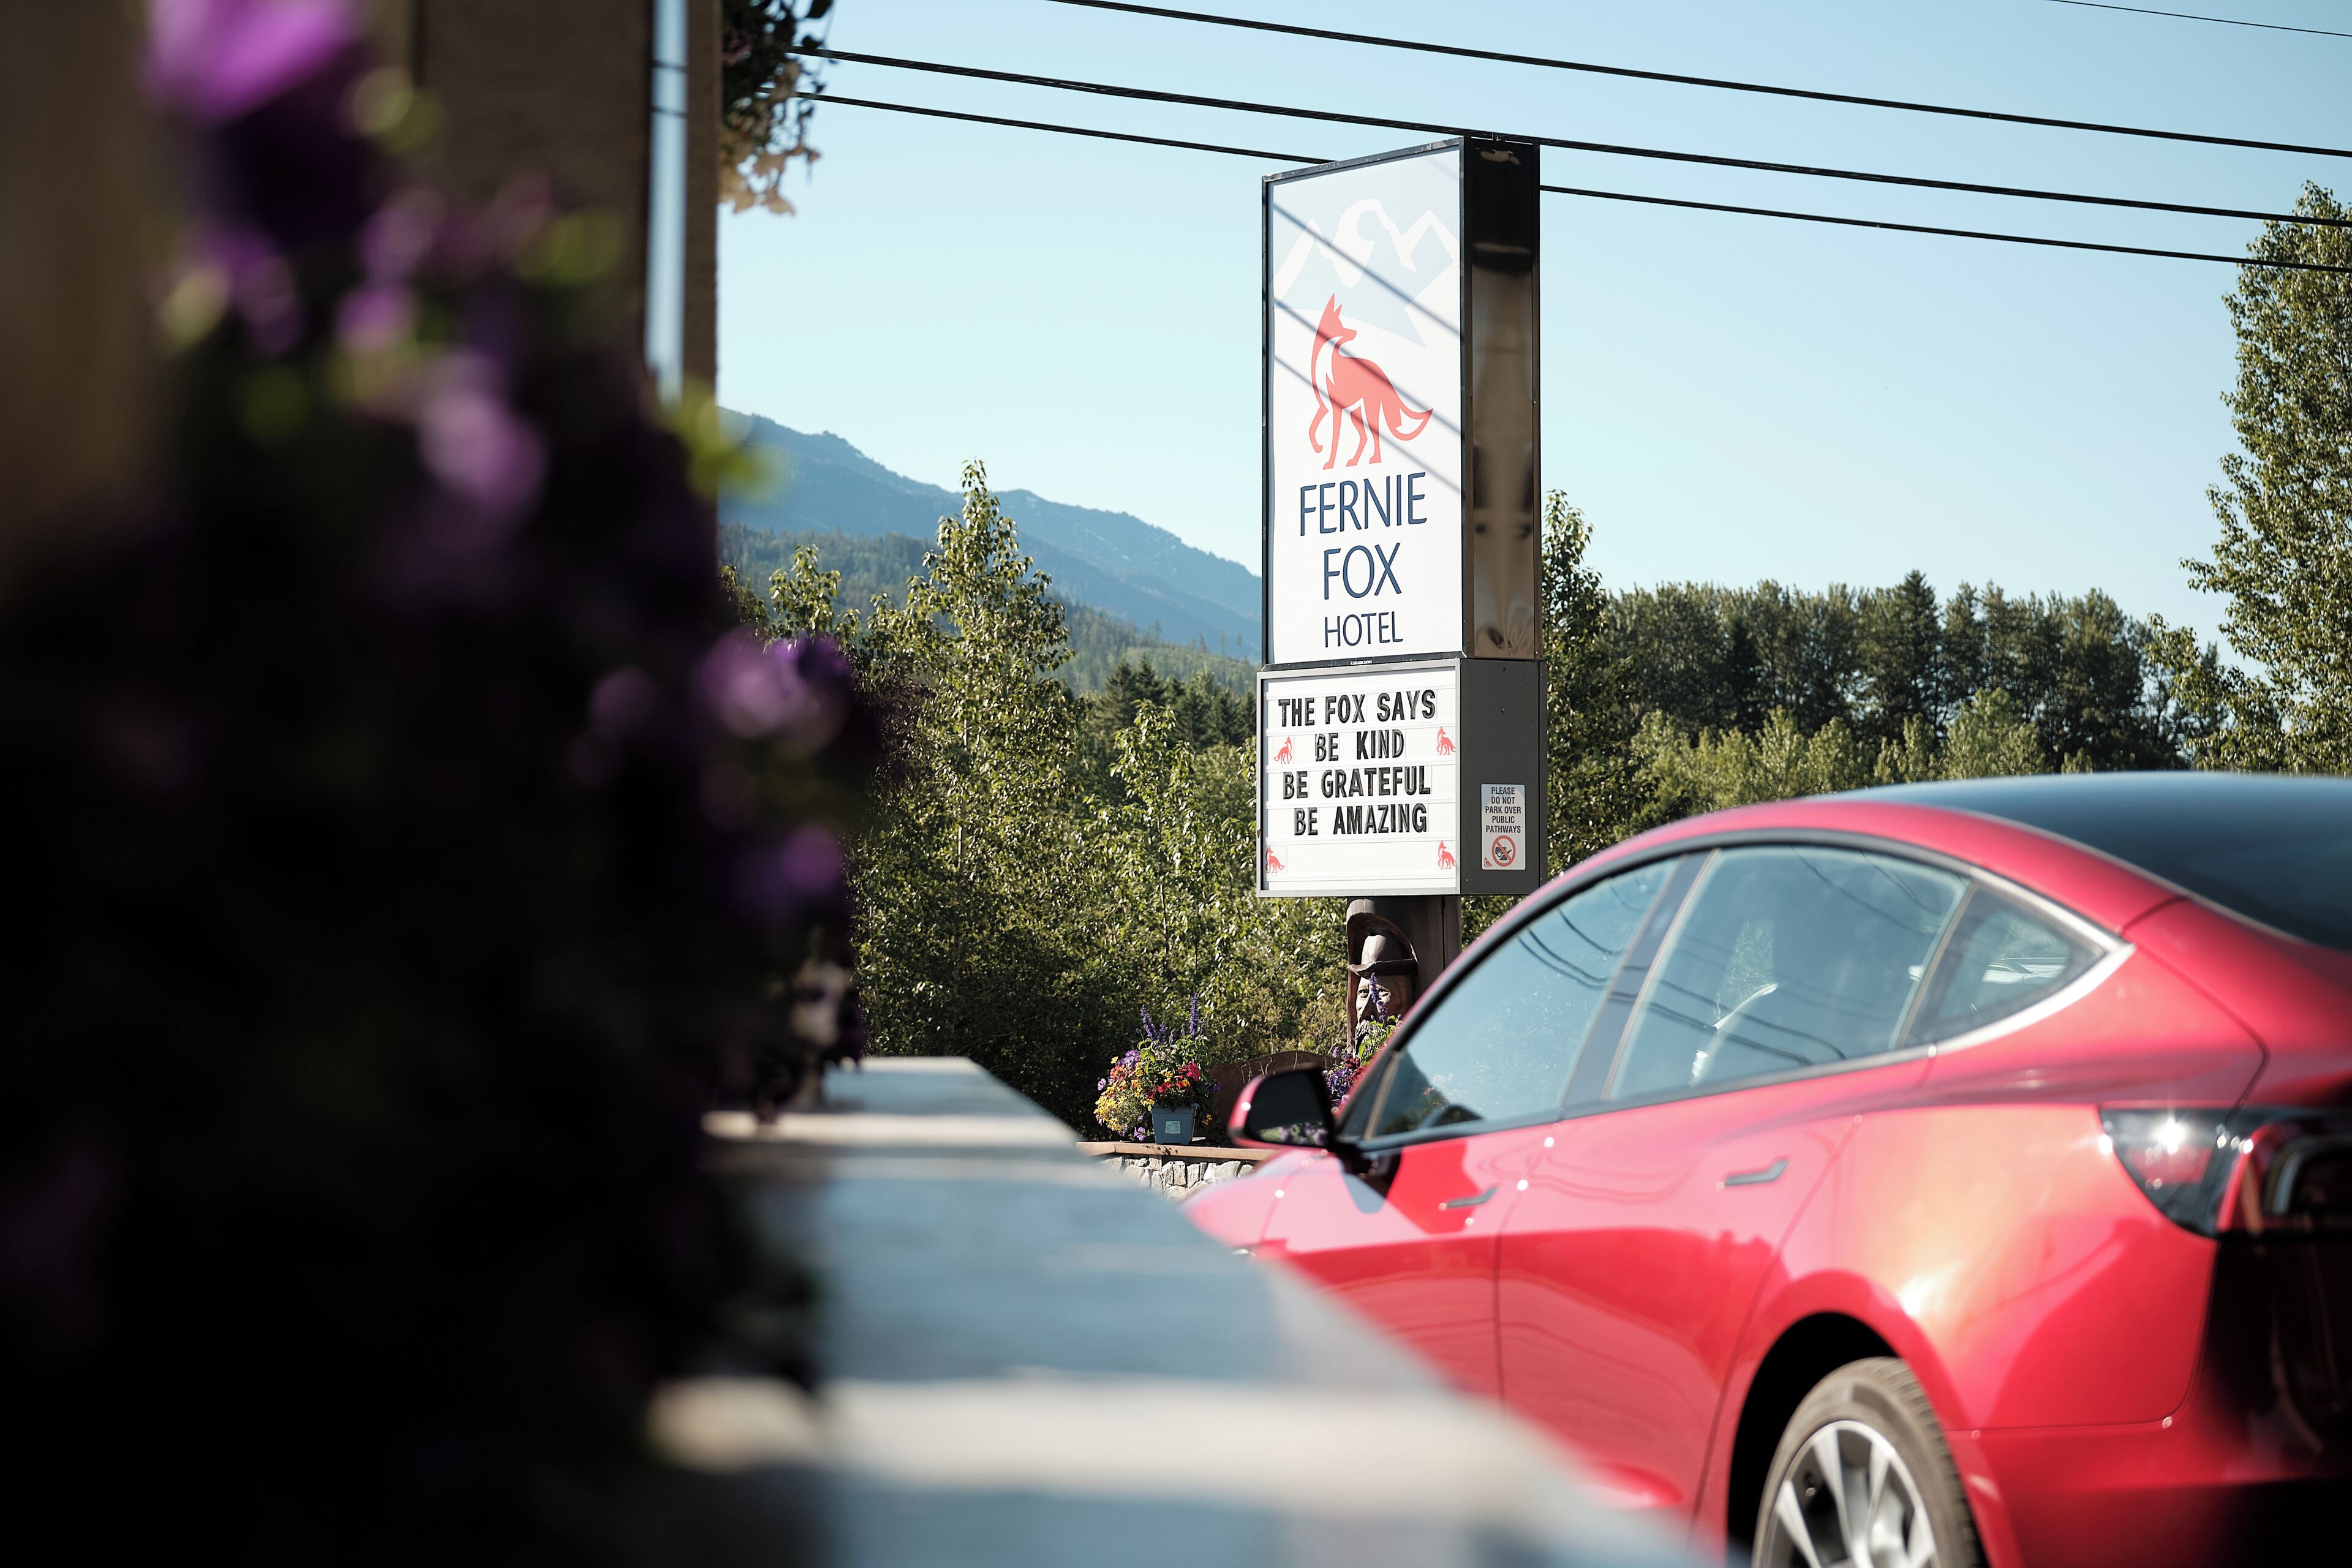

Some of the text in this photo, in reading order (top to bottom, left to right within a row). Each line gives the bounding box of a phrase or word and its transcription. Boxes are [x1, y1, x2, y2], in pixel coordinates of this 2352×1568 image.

[1300, 472, 1427, 537] FERNIE
[1324, 543, 1402, 600] FOX
[1325, 611, 1403, 647] HOTEL
[1278, 690, 1436, 727] THE FOX SAYS
[1315, 729, 1404, 762] BE KIND
[1283, 766, 1431, 799] BE GRATEFUL
[1294, 803, 1427, 836] BE AMAZING
